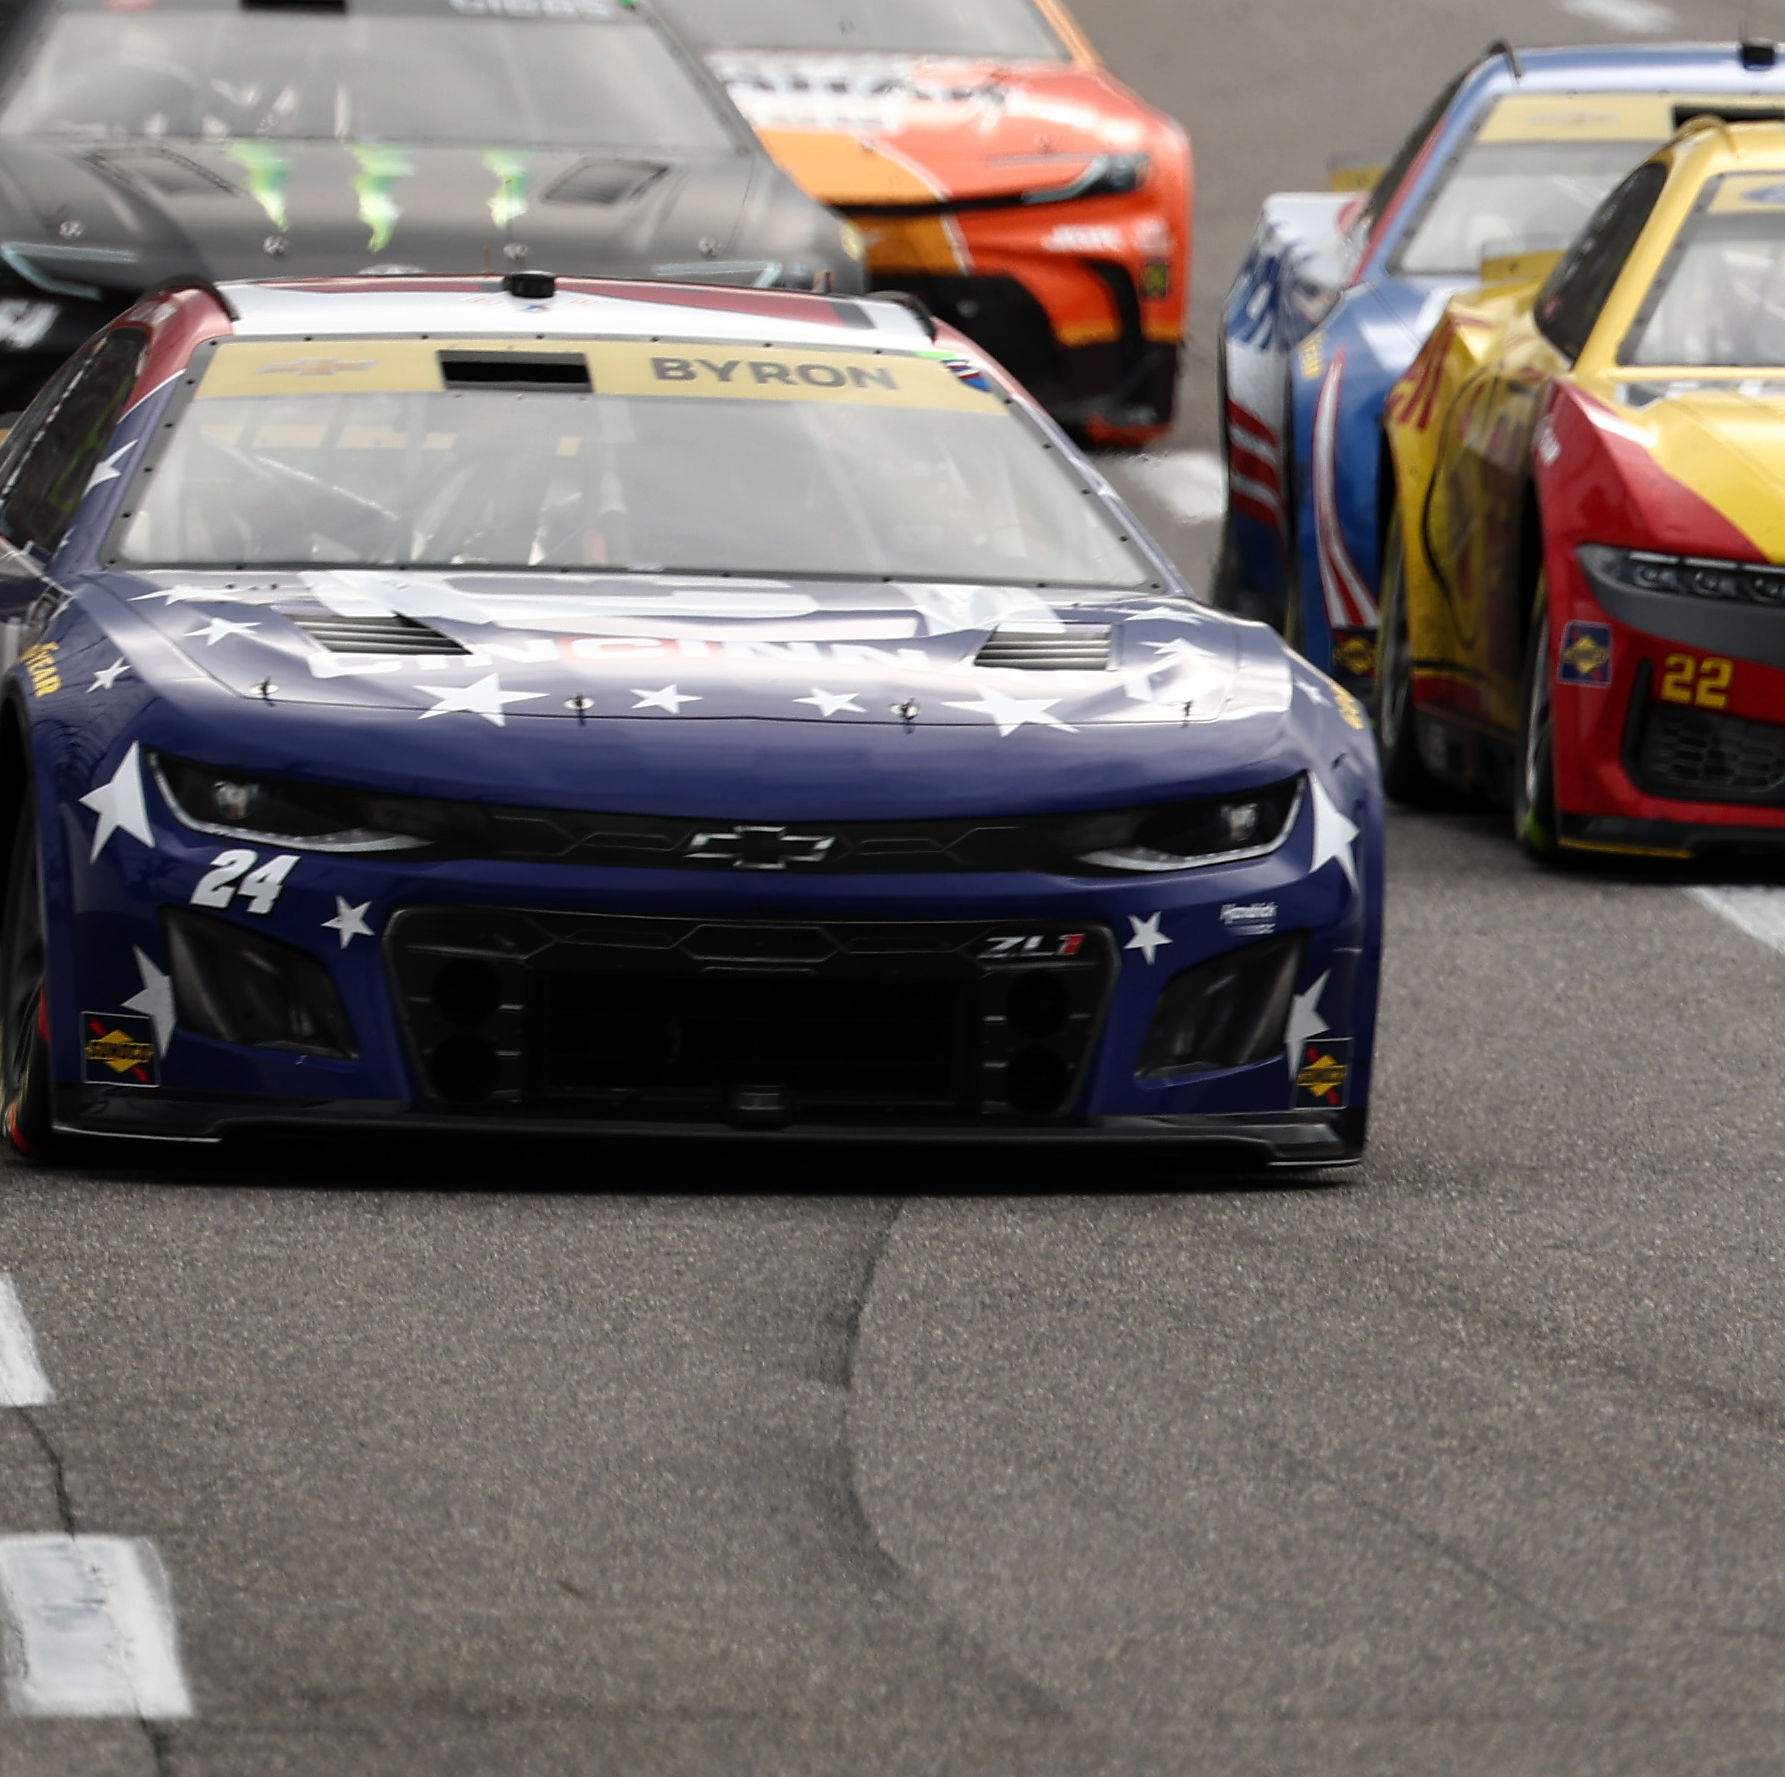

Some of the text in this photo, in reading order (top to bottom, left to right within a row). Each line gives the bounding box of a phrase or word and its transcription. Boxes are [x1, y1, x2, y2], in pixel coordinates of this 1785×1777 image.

[650, 356, 900, 392] BYRON
[1661, 652, 1733, 709] 22
[189, 848, 301, 914] 24
[975, 933, 1086, 959] ZL1
